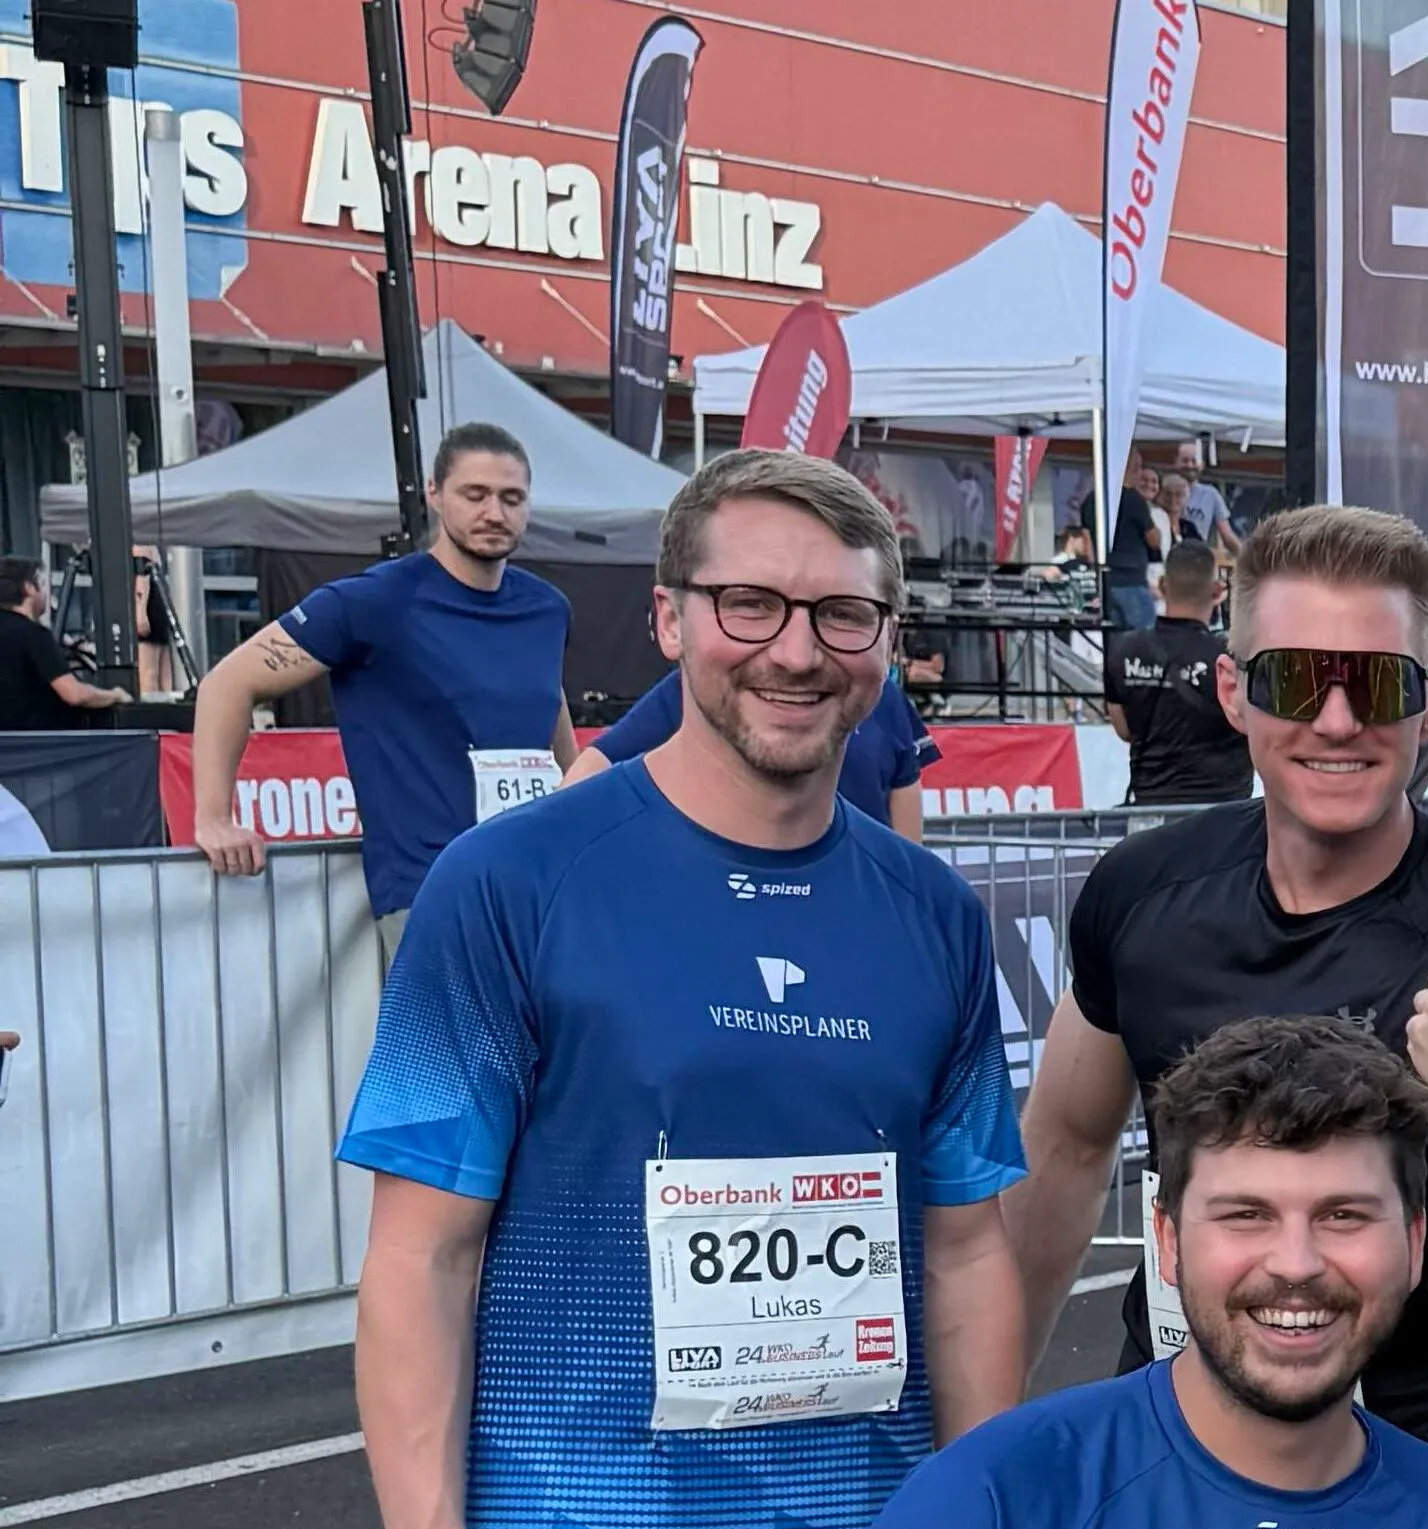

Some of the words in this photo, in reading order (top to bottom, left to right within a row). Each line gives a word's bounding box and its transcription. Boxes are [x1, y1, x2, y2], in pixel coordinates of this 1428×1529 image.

[1110, 0, 1187, 302] Oberbank
[675, 158, 823, 290] inz
[232, 774, 363, 838] rone
[761, 881, 812, 897] spized
[709, 1004, 871, 1042] VEREINSPLANER
[660, 1182, 783, 1206] Oberbank
[793, 1174, 861, 1202] WKO
[688, 1224, 867, 1285] 820-C
[751, 1295, 823, 1319] Lukas
